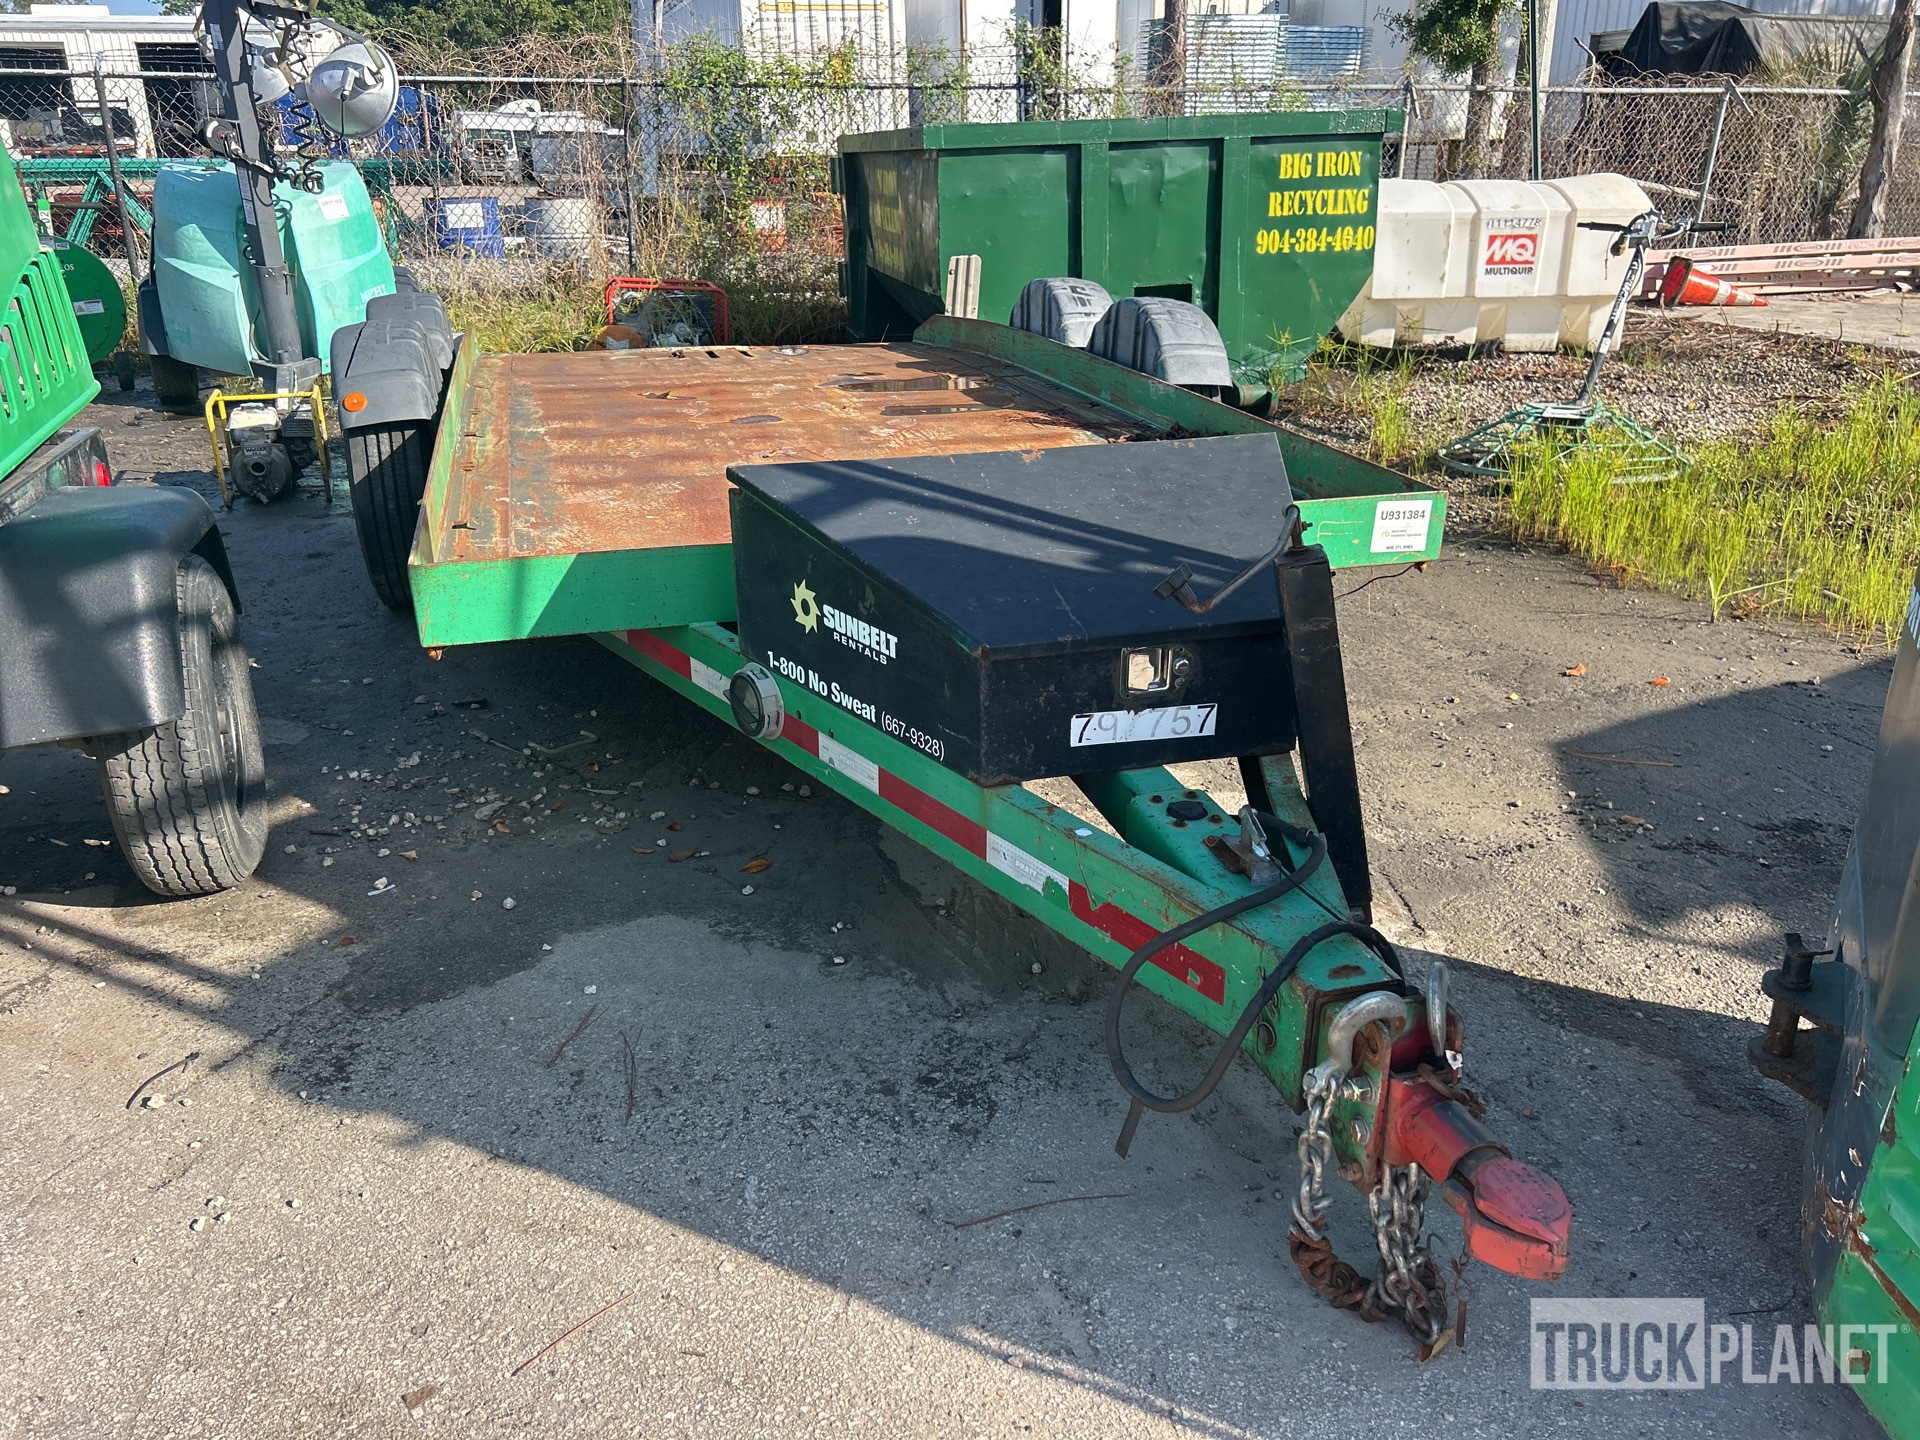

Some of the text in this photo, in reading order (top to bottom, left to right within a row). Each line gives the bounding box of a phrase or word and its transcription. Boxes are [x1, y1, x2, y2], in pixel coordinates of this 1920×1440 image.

[1279, 151, 1362, 179] BIG IRON
[1268, 189, 1369, 217] RECYCLING
[1486, 236, 1535, 263] MQ
[1381, 510, 1426, 521] U931384
[823, 604, 898, 659] SUNBELT
[833, 631, 887, 665] RENTALS
[767, 650, 945, 762] 1-800 No Sweat (667-9328)
